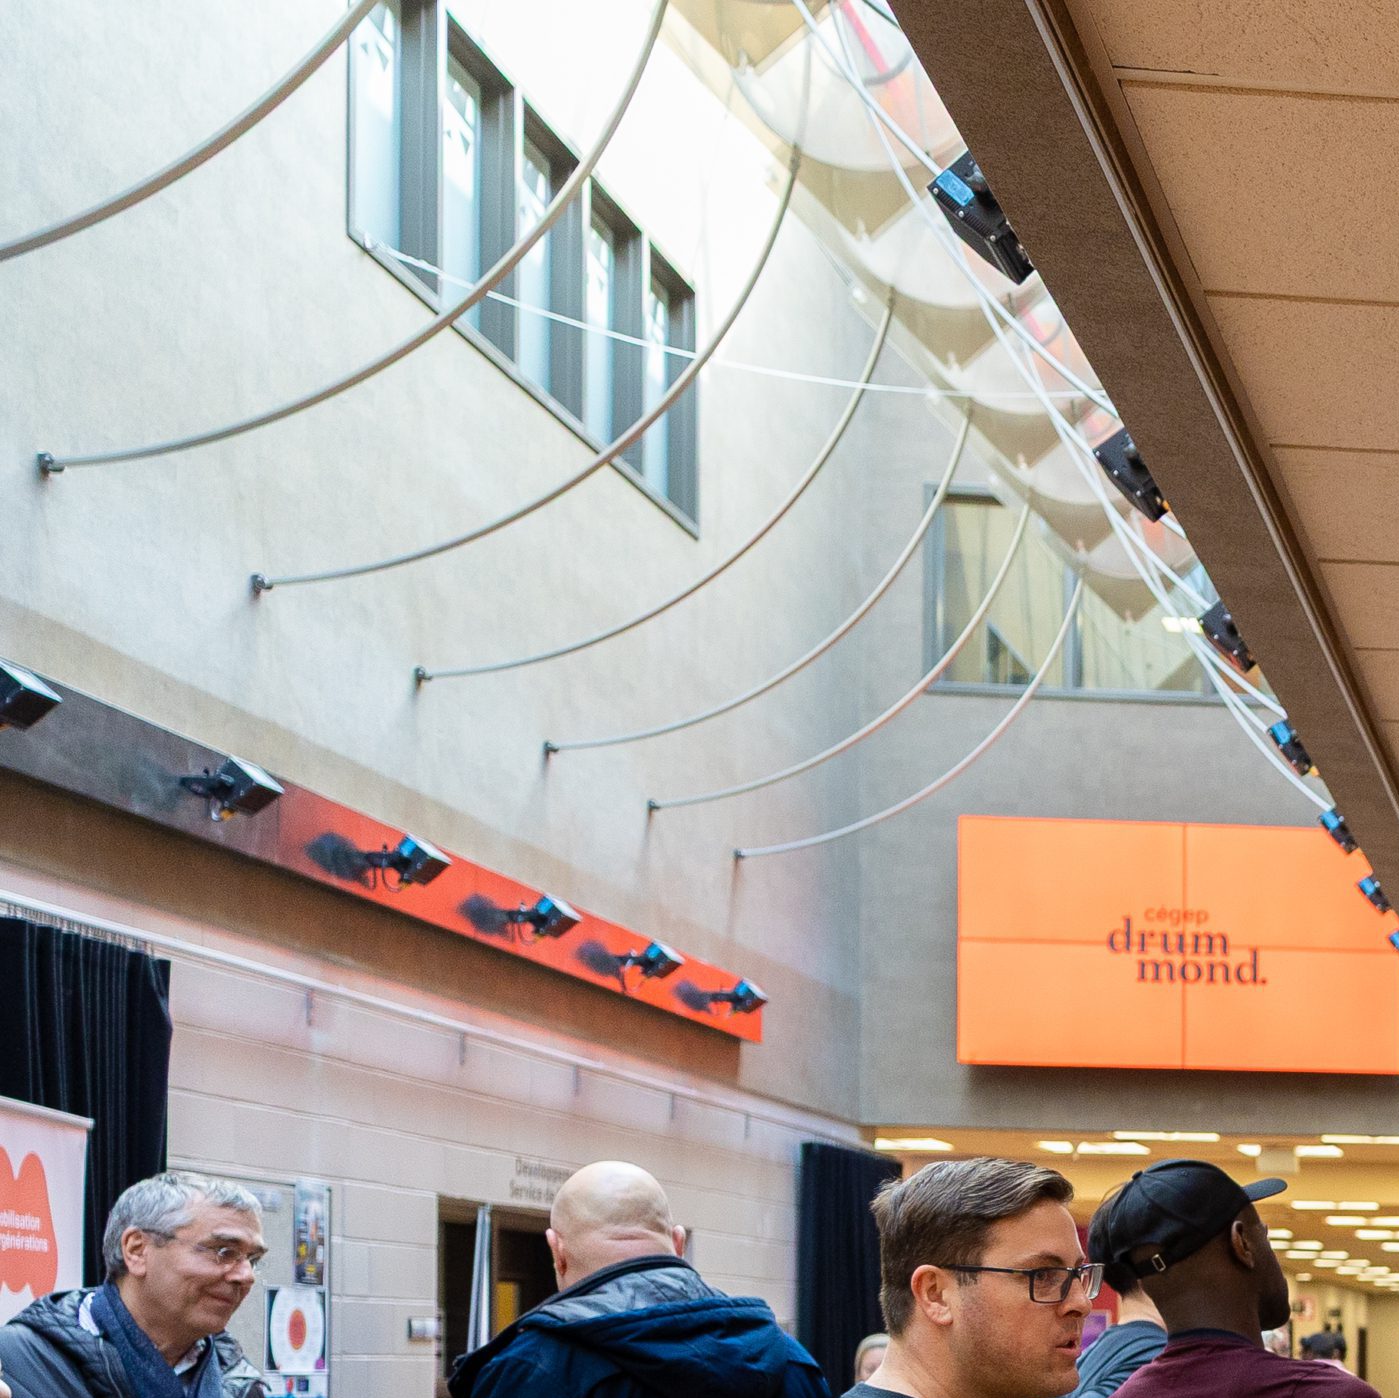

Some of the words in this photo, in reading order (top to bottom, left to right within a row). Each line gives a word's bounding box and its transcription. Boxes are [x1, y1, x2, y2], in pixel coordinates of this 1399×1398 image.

[1144, 906, 1209, 925] cégep
[1107, 917, 1229, 955] drum
[1137, 948, 1268, 985] mond.
[0, 1210, 40, 1231] obilisation
[0, 1232, 48, 1252] générations
